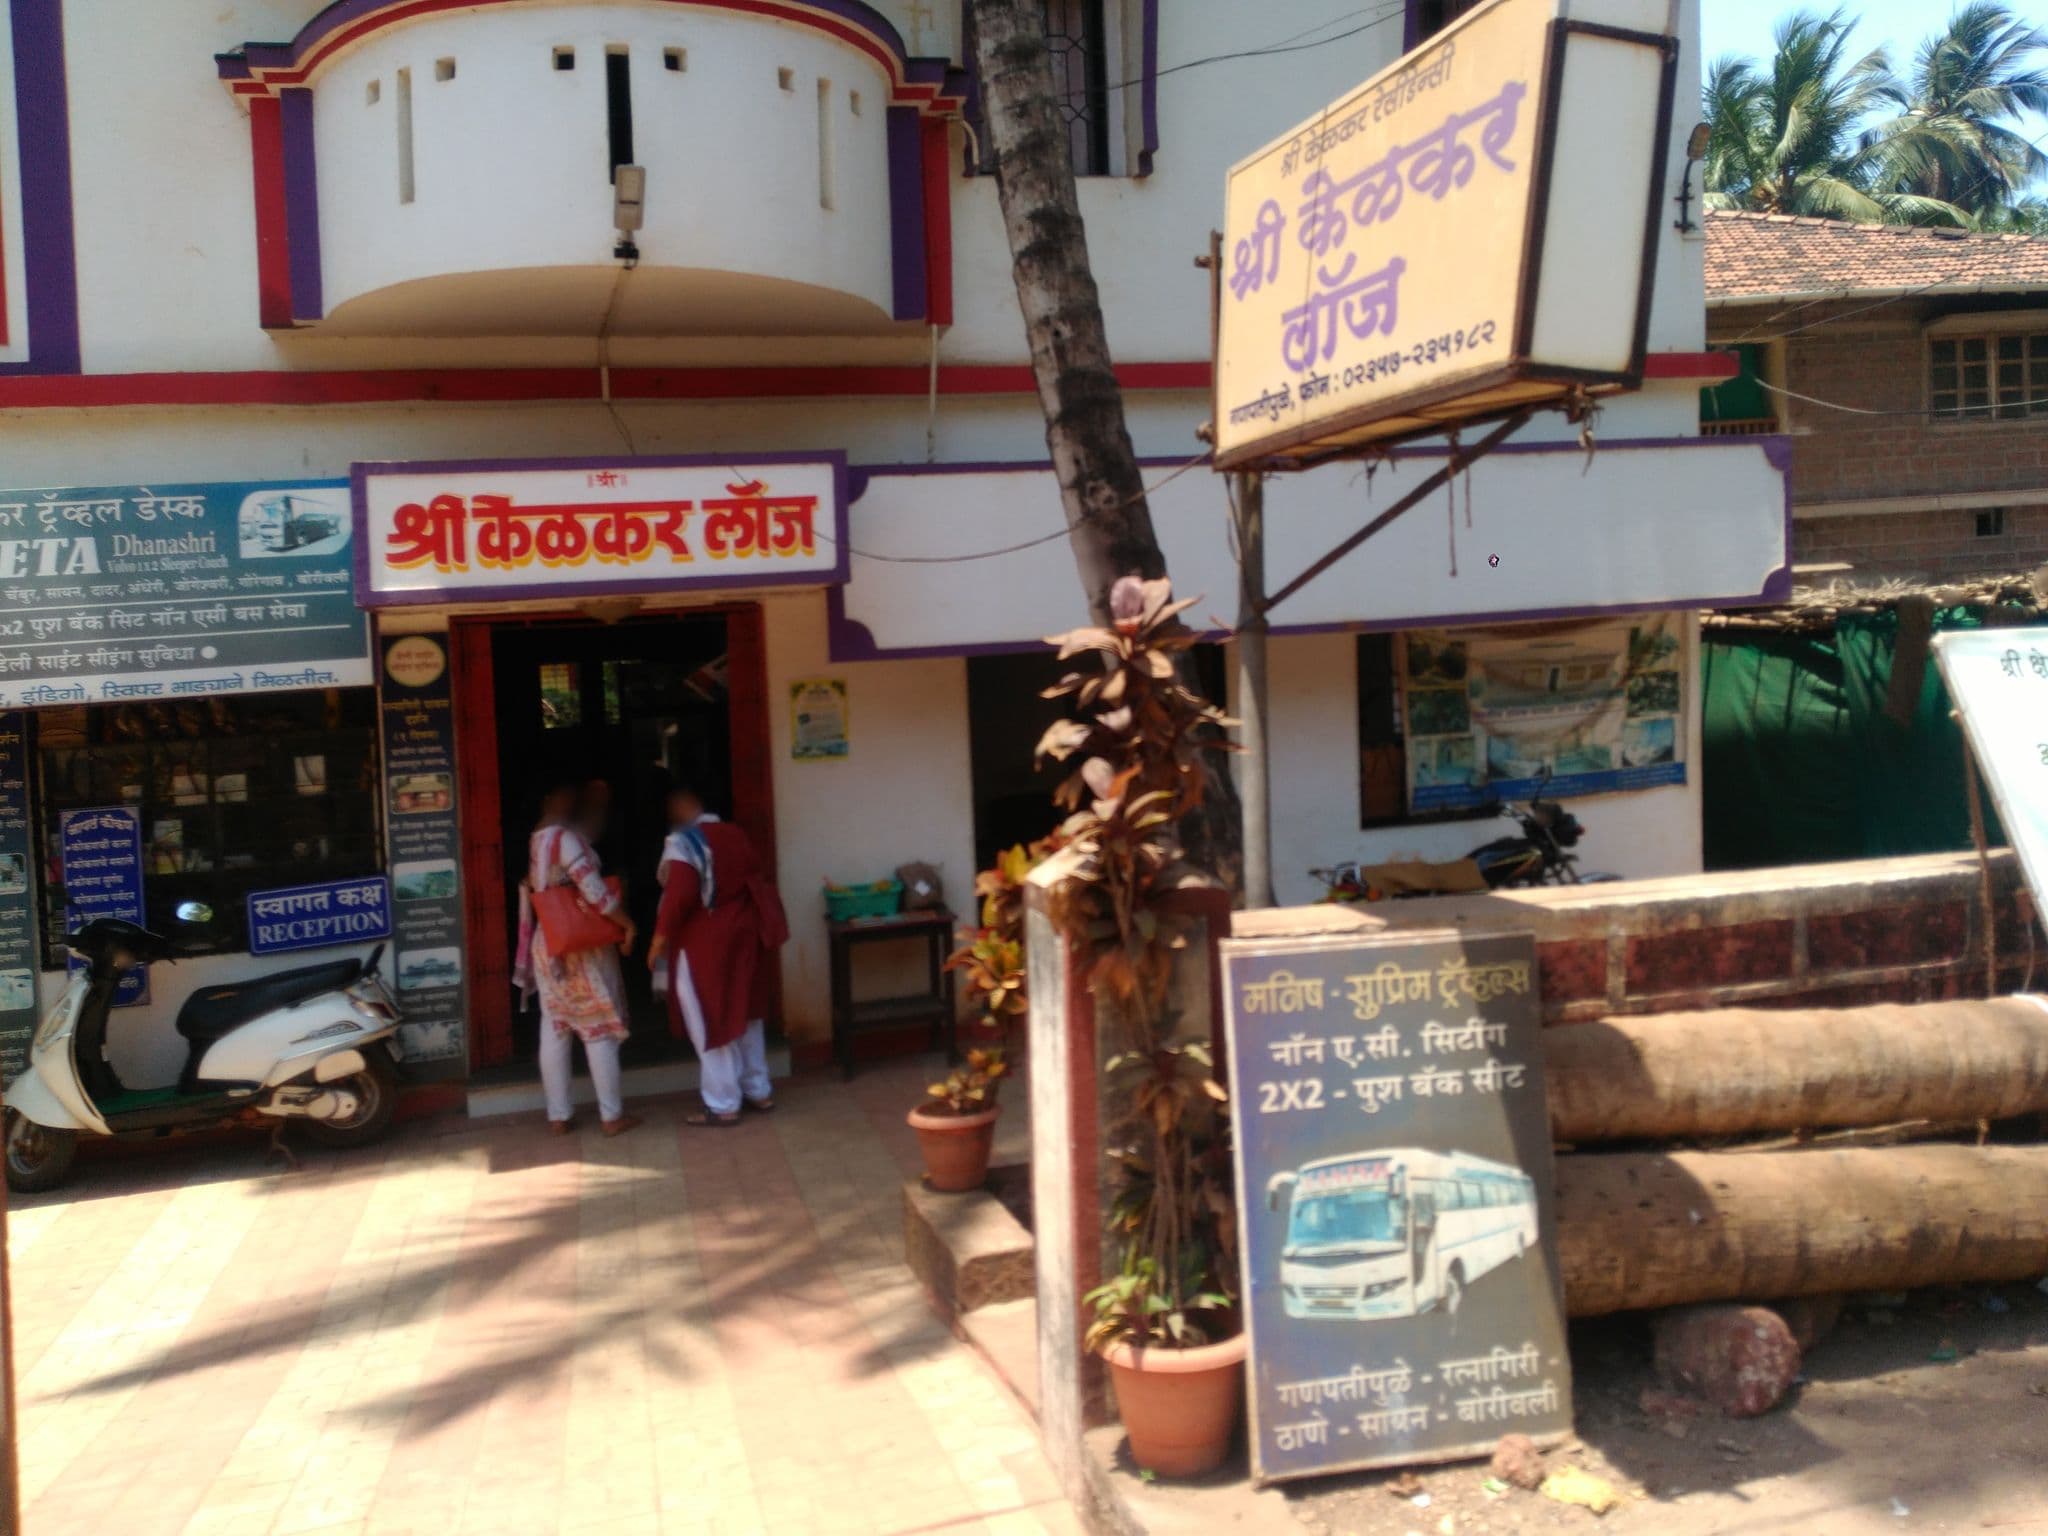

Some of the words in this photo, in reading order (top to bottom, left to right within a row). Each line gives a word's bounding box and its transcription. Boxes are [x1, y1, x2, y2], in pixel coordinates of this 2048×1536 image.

[1229, 199, 1286, 301] श्री
[1298, 81, 1527, 256] केळकर
[1281, 253, 1407, 373] लॉज
[34, 492, 126, 532] ट्रॅव्हल
[131, 487, 206, 520] डेस्क
[701, 480, 818, 563] लॉज
[112, 531, 216, 557] Dhanashri
[151, 607, 187, 627] नॉन
[190, 603, 228, 628] एसी
[232, 606, 265, 622] बस
[269, 600, 307, 619] सेवा
[137, 644, 196, 668] सुविधा
[2000, 648, 2025, 678] श्री
[253, 892, 331, 919] स्वागत
[336, 884, 384, 907] कक्ष
[256, 910, 384, 944] RECEPTION
[1268, 1032, 1326, 1066] नॉन
[1258, 1077, 1326, 1113] 2X2
[1352, 1074, 1404, 1114] पुश
[1408, 1065, 1464, 1098] बॅक
[1469, 1058, 1527, 1093] सीट
[1275, 1355, 1415, 1407] गणपतीपुळे
[1439, 1342, 1540, 1387] रत्नागिरी
[1275, 1409, 1330, 1451] ठाणे
[1456, 1378, 1559, 1423] बोरीवली
